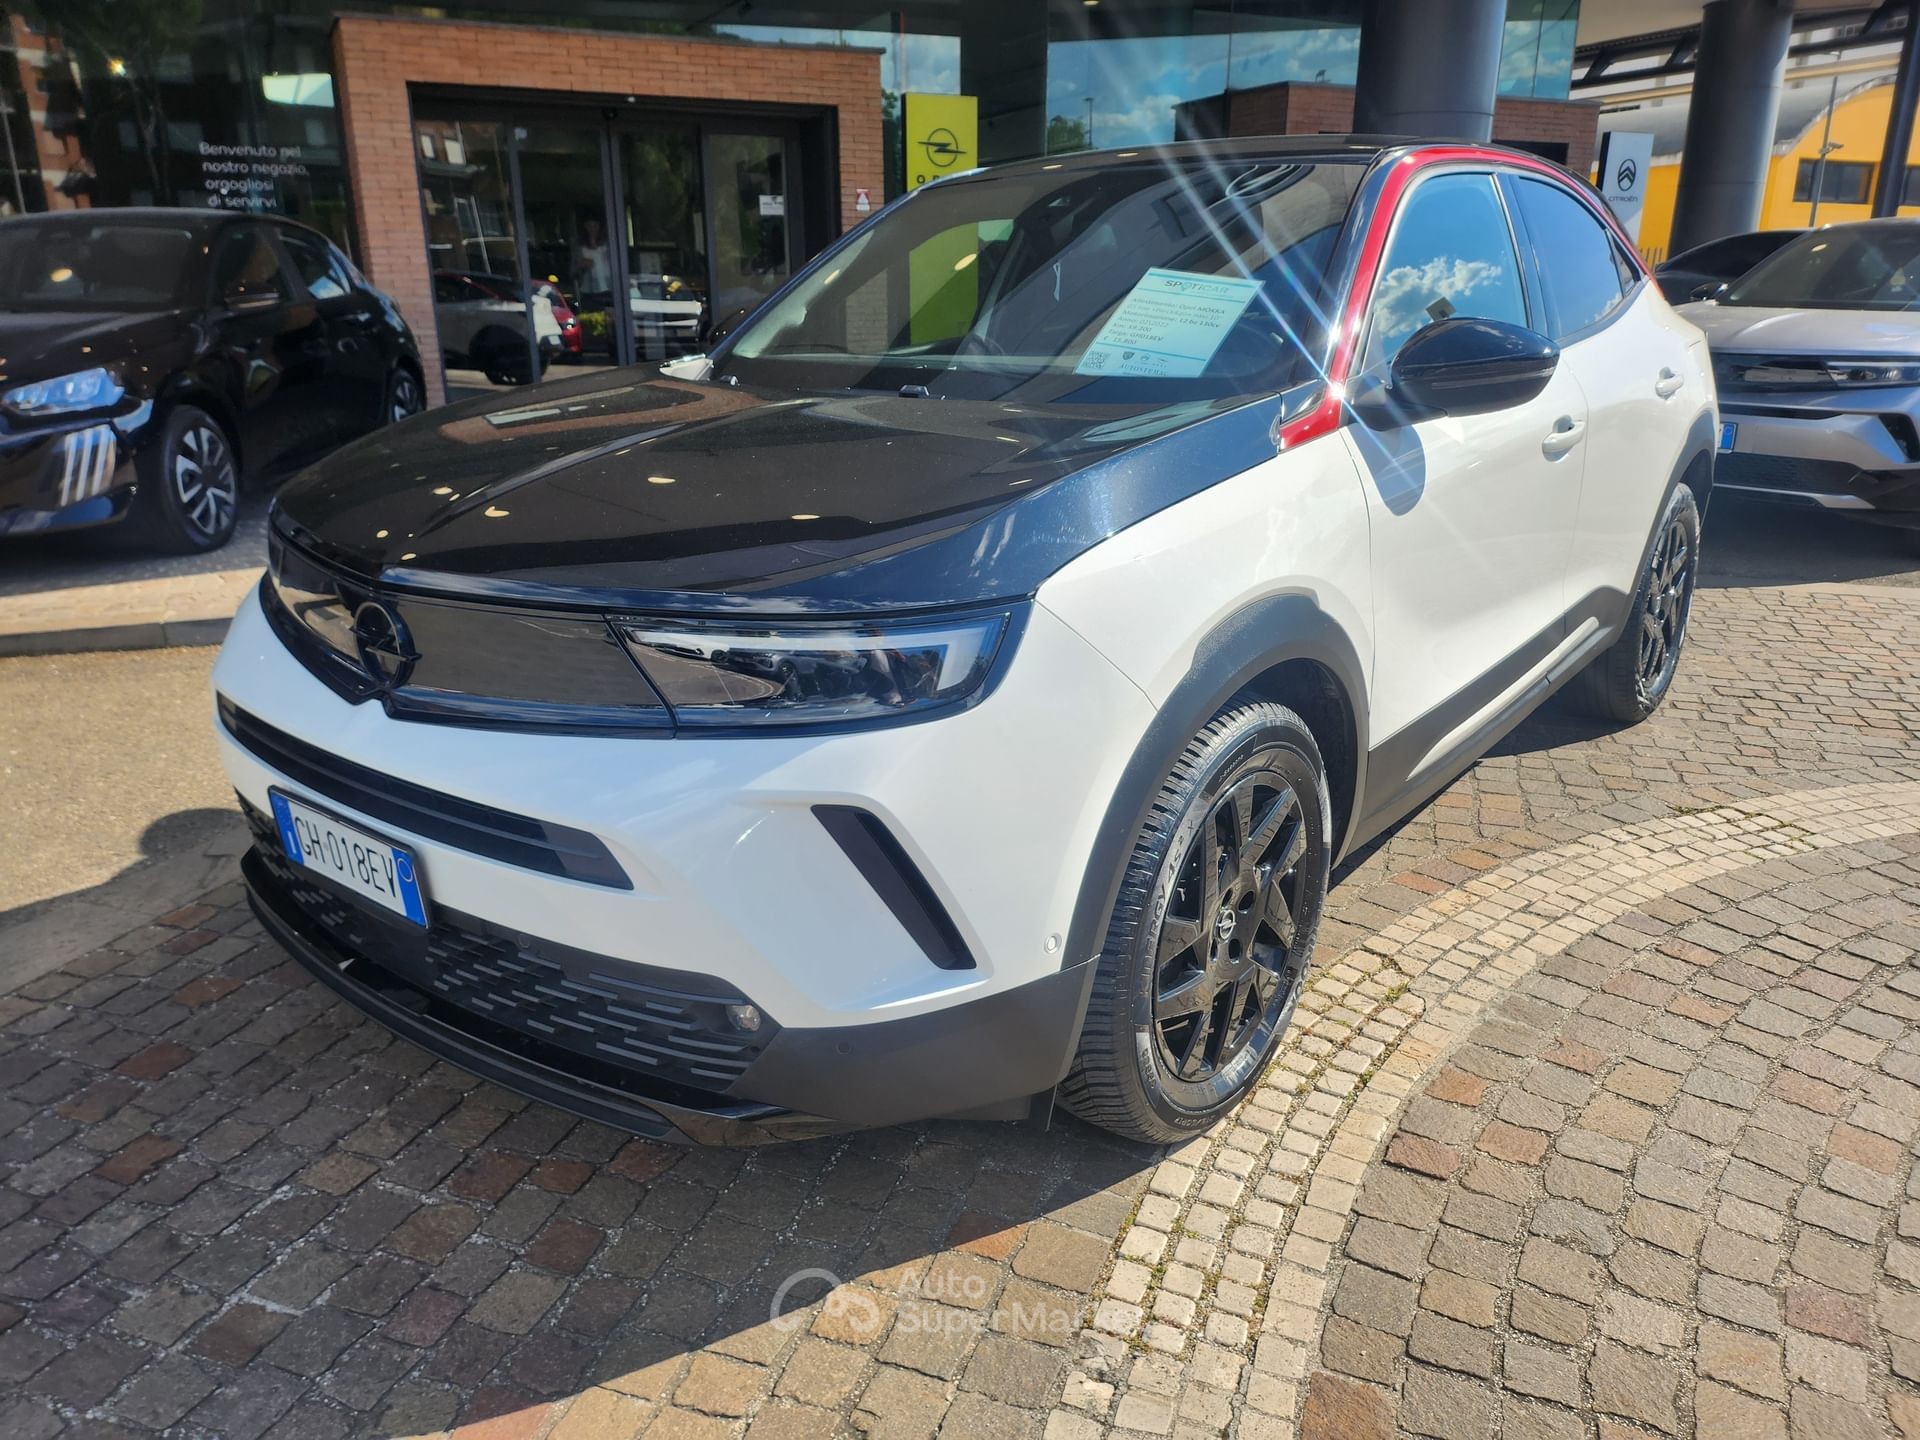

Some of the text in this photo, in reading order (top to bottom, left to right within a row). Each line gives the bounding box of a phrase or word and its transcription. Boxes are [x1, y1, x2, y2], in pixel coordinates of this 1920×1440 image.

[198, 141, 302, 158] Benvenuto nel
[202, 160, 249, 173] nostro
[205, 178, 274, 193] orgogliosi
[208, 194, 277, 208] di servirvi
[1164, 279, 1229, 294] SPOTICAR
